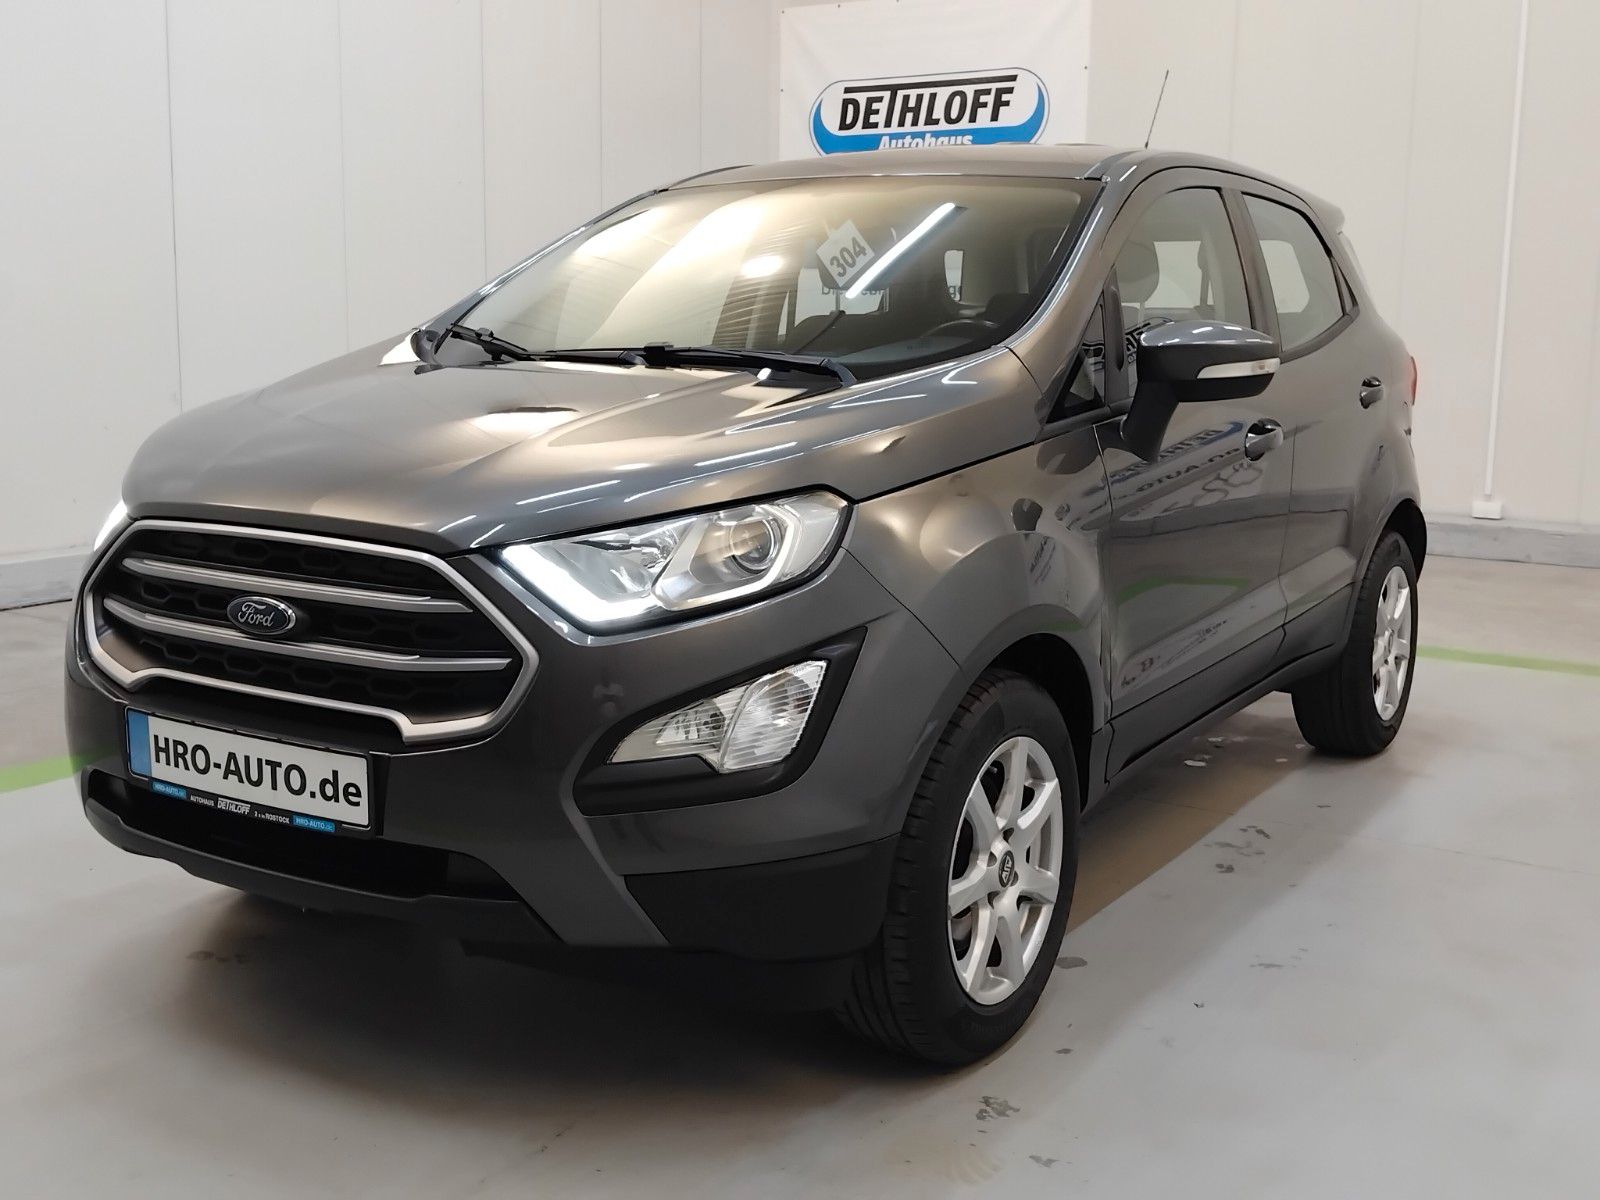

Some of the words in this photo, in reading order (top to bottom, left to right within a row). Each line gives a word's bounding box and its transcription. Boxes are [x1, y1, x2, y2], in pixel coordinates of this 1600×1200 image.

[838, 74, 1018, 131] DETHLOFF
[830, 237, 867, 278] 304
[238, 602, 275, 627] Ford
[153, 734, 362, 807] HRO-AUTO.de
[217, 797, 250, 815] DETHLOFF
